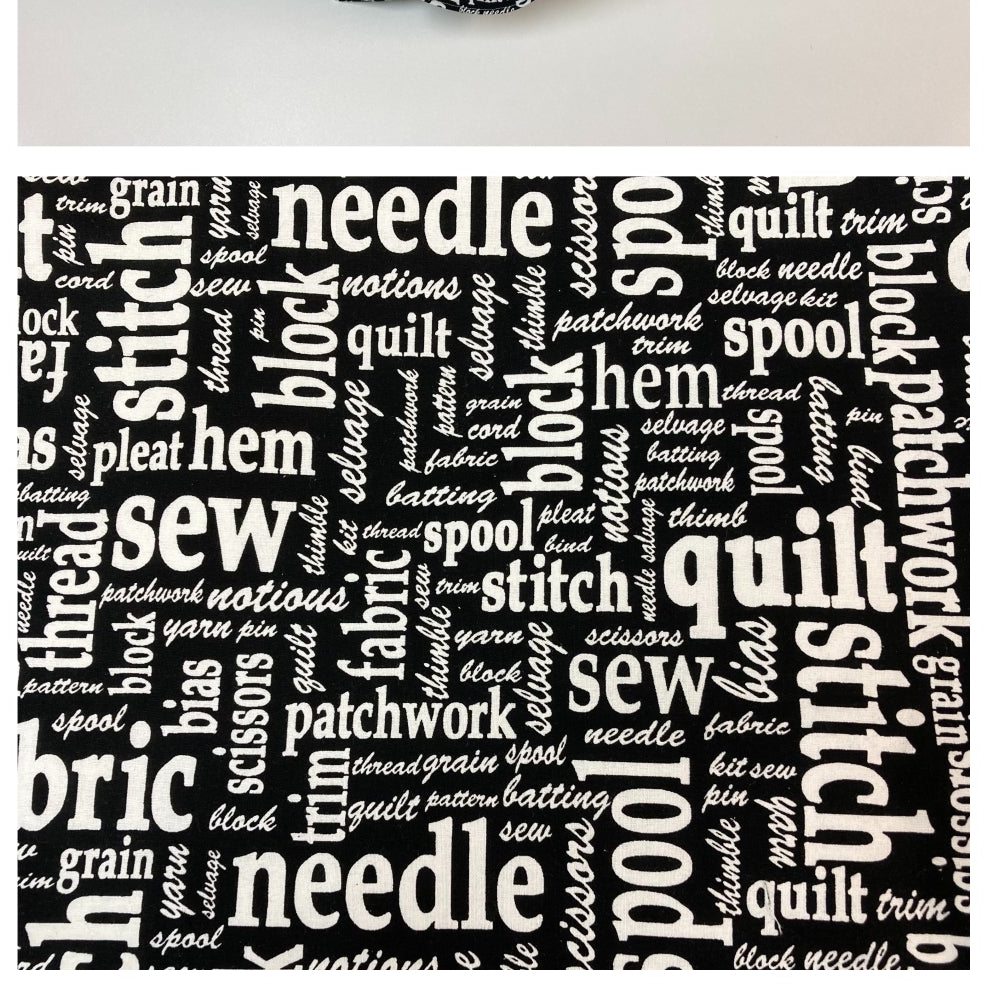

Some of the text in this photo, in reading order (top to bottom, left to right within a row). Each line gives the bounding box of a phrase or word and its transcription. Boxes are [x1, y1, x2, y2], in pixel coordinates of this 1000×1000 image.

[56, 196, 107, 213] trim
[110, 178, 200, 219] grain
[271, 177, 553, 257] needle
[729, 191, 833, 252] quilt
[840, 208, 907, 235] trim
[55, 271, 115, 289] cord
[190, 278, 251, 297] sew
[200, 245, 267, 269] spool
[717, 258, 770, 279] block
[778, 252, 862, 280] needle
[85, 216, 192, 421] stitch
[458, 273, 508, 381] selvage
[513, 265, 546, 351] thimble
[552, 302, 703, 341] patchwork
[708, 283, 797, 313] selvage
[867, 240, 939, 364] block
[197, 308, 232, 393] thread
[250, 263, 339, 408] block
[348, 312, 451, 370] quilt
[632, 336, 691, 355] trim
[724, 301, 865, 376] spool
[433, 366, 463, 437] pattern
[592, 342, 722, 410] hem
[722, 381, 802, 401] thread
[189, 405, 315, 475] hem
[328, 380, 384, 504] selvage
[396, 369, 420, 473] patchwork
[500, 353, 583, 495] block
[641, 411, 725, 443] selvage
[731, 409, 803, 496] spool
[802, 376, 842, 485] batting
[90, 427, 184, 486] pleat
[424, 446, 498, 475] fabric
[633, 467, 734, 498] patchwork
[647, 441, 720, 469] batting
[848, 445, 882, 510] bind
[386, 481, 497, 513] batting
[537, 500, 595, 531] pleat
[860, 366, 970, 647] patchwork
[112, 495, 297, 572] sew
[298, 496, 328, 575] thimble
[333, 520, 358, 555] kit
[424, 497, 534, 566] spool
[19, 508, 108, 670] thread
[99, 578, 204, 609] patchwork
[482, 552, 632, 612] stitch
[664, 506, 898, 639] quilt
[163, 619, 232, 646] yarn
[337, 550, 411, 680] fabric
[585, 629, 683, 646] scissors
[108, 612, 156, 695] block
[513, 622, 567, 736] selvage
[569, 654, 714, 715] sew
[712, 617, 778, 702] bias
[52, 704, 127, 740] spool
[161, 659, 222, 736] bias
[213, 653, 273, 794] scissors
[282, 685, 516, 757] patchwork
[704, 711, 790, 740] fabric
[913, 655, 968, 745] grain
[505, 736, 567, 773] spool
[585, 720, 685, 746] needle
[795, 622, 934, 866] stitch
[288, 748, 350, 844] trim
[422, 750, 497, 784] grain
[503, 774, 610, 820] batting
[209, 804, 277, 831] block
[57, 835, 153, 894] grain
[160, 844, 195, 918] yarn
[228, 816, 544, 932] needle
[706, 819, 742, 916] thimble
[747, 866, 867, 936] quilt
[877, 889, 949, 920] trim
[150, 925, 224, 955] spool
